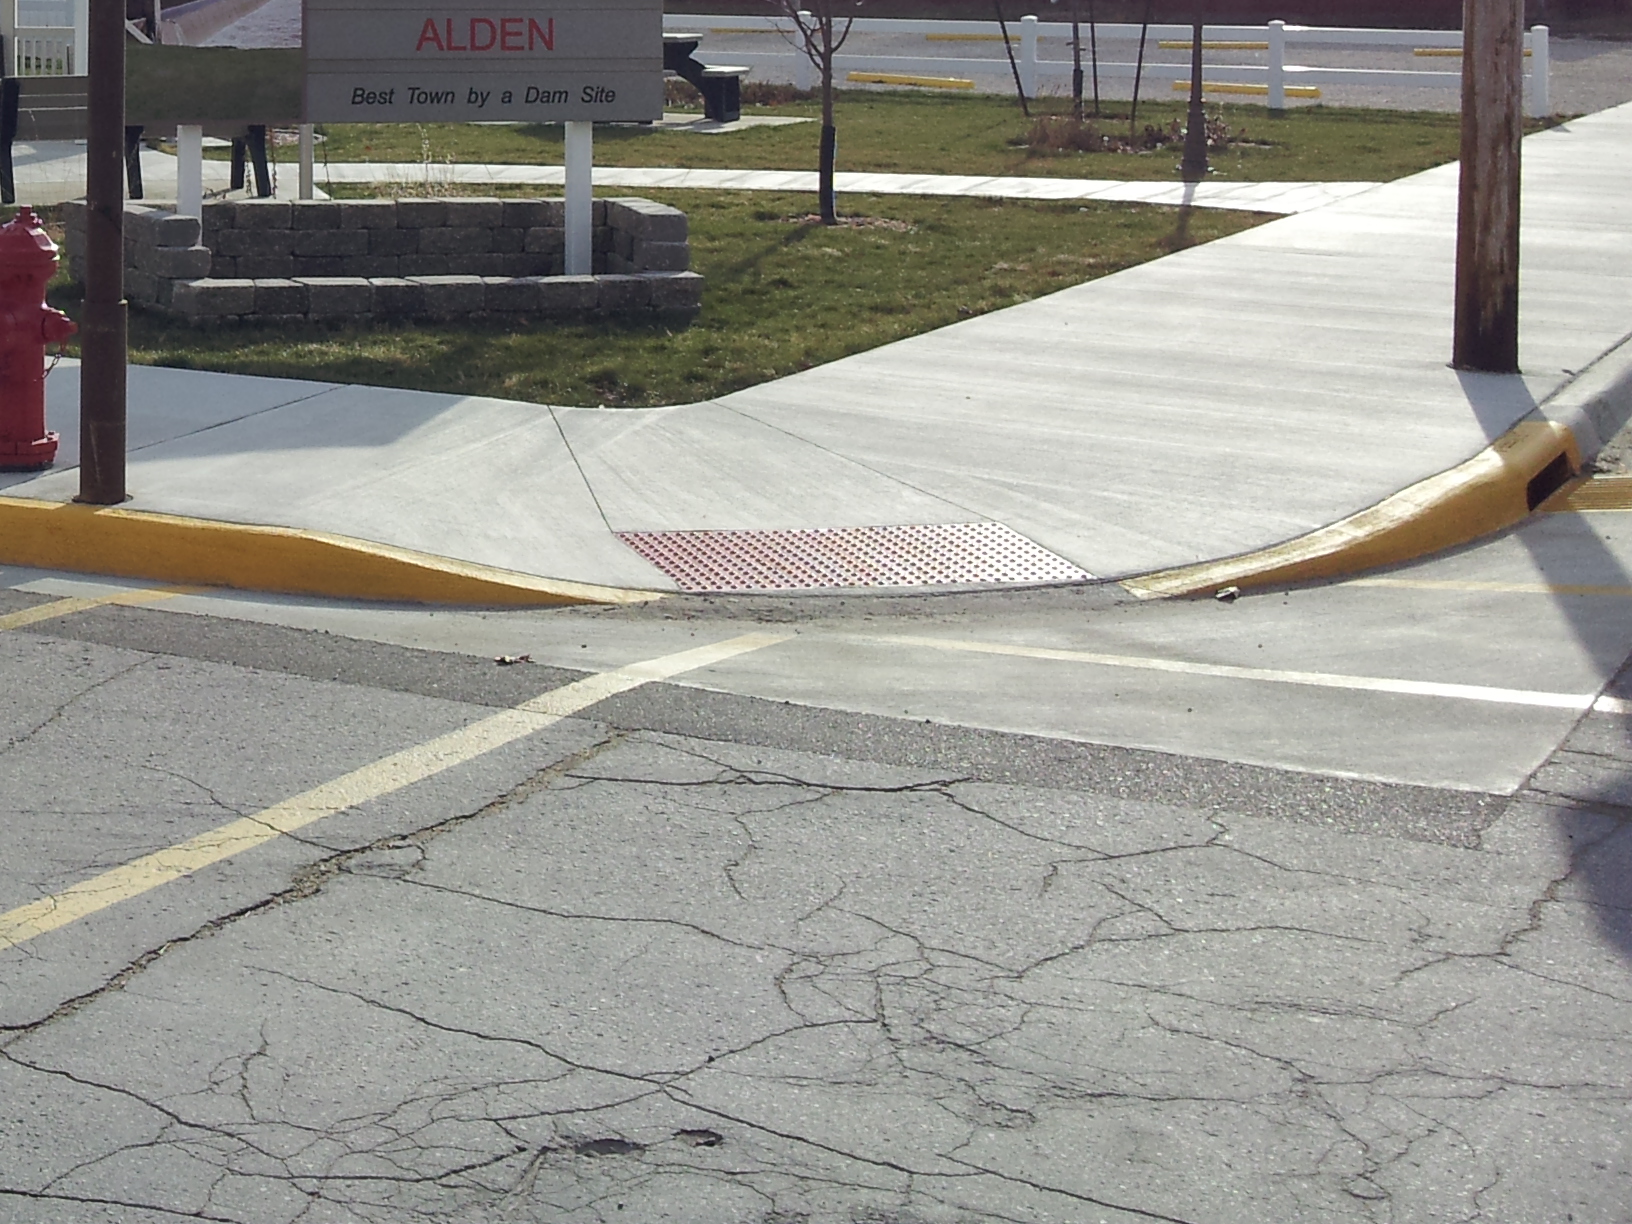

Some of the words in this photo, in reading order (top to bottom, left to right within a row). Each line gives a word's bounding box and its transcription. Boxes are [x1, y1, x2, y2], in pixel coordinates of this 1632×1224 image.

[415, 17, 555, 52] ALDEN
[351, 86, 394, 106] Best
[407, 86, 456, 106] Town
[467, 86, 491, 109] by
[501, 91, 513, 105] a
[524, 86, 569, 104] Dam
[581, 85, 616, 104] Site
